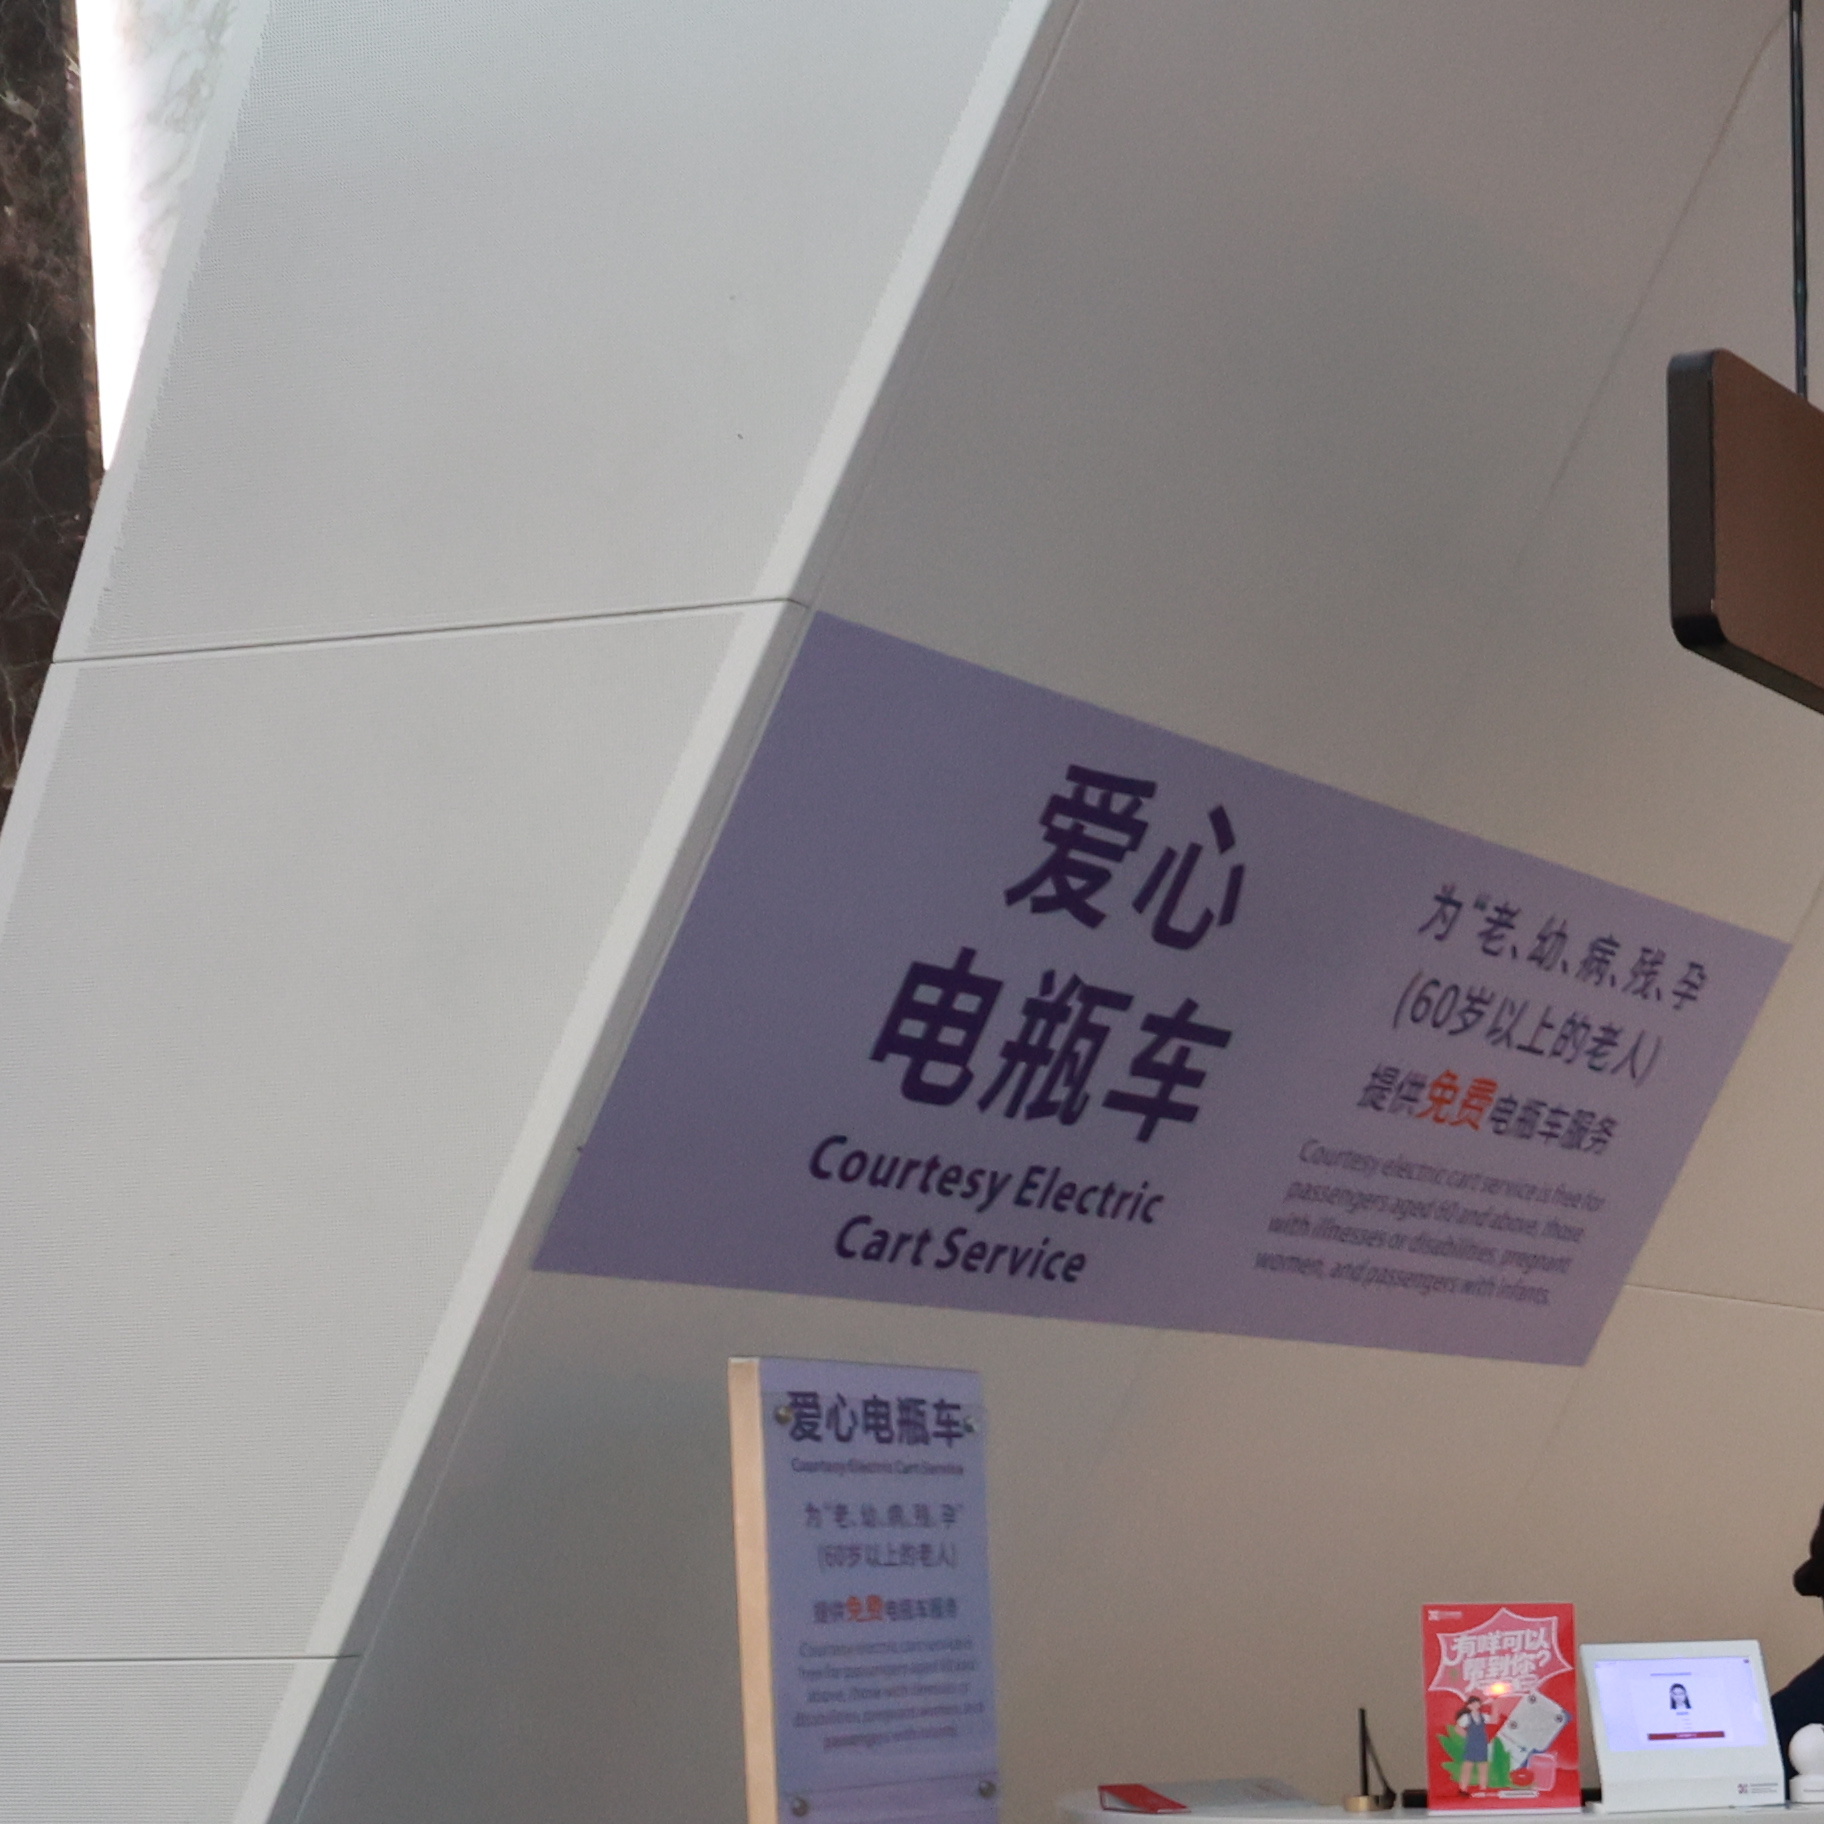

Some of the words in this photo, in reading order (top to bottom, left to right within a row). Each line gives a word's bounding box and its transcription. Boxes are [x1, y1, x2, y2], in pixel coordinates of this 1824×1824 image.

[1004, 763, 1247, 951] 爱心
[869, 946, 1231, 1143] 电瓶车
[1393, 969, 1663, 1088] (60岁以上的老人)
[1359, 1063, 1617, 1155] 提供免费电瓶车服务
[809, 1134, 1013, 1213] Courtesy
[1013, 1166, 1165, 1224] Electric
[834, 1214, 934, 1267] Cart
[934, 1226, 1087, 1283] Service
[786, 1391, 964, 1449] 爱心电瓶车
